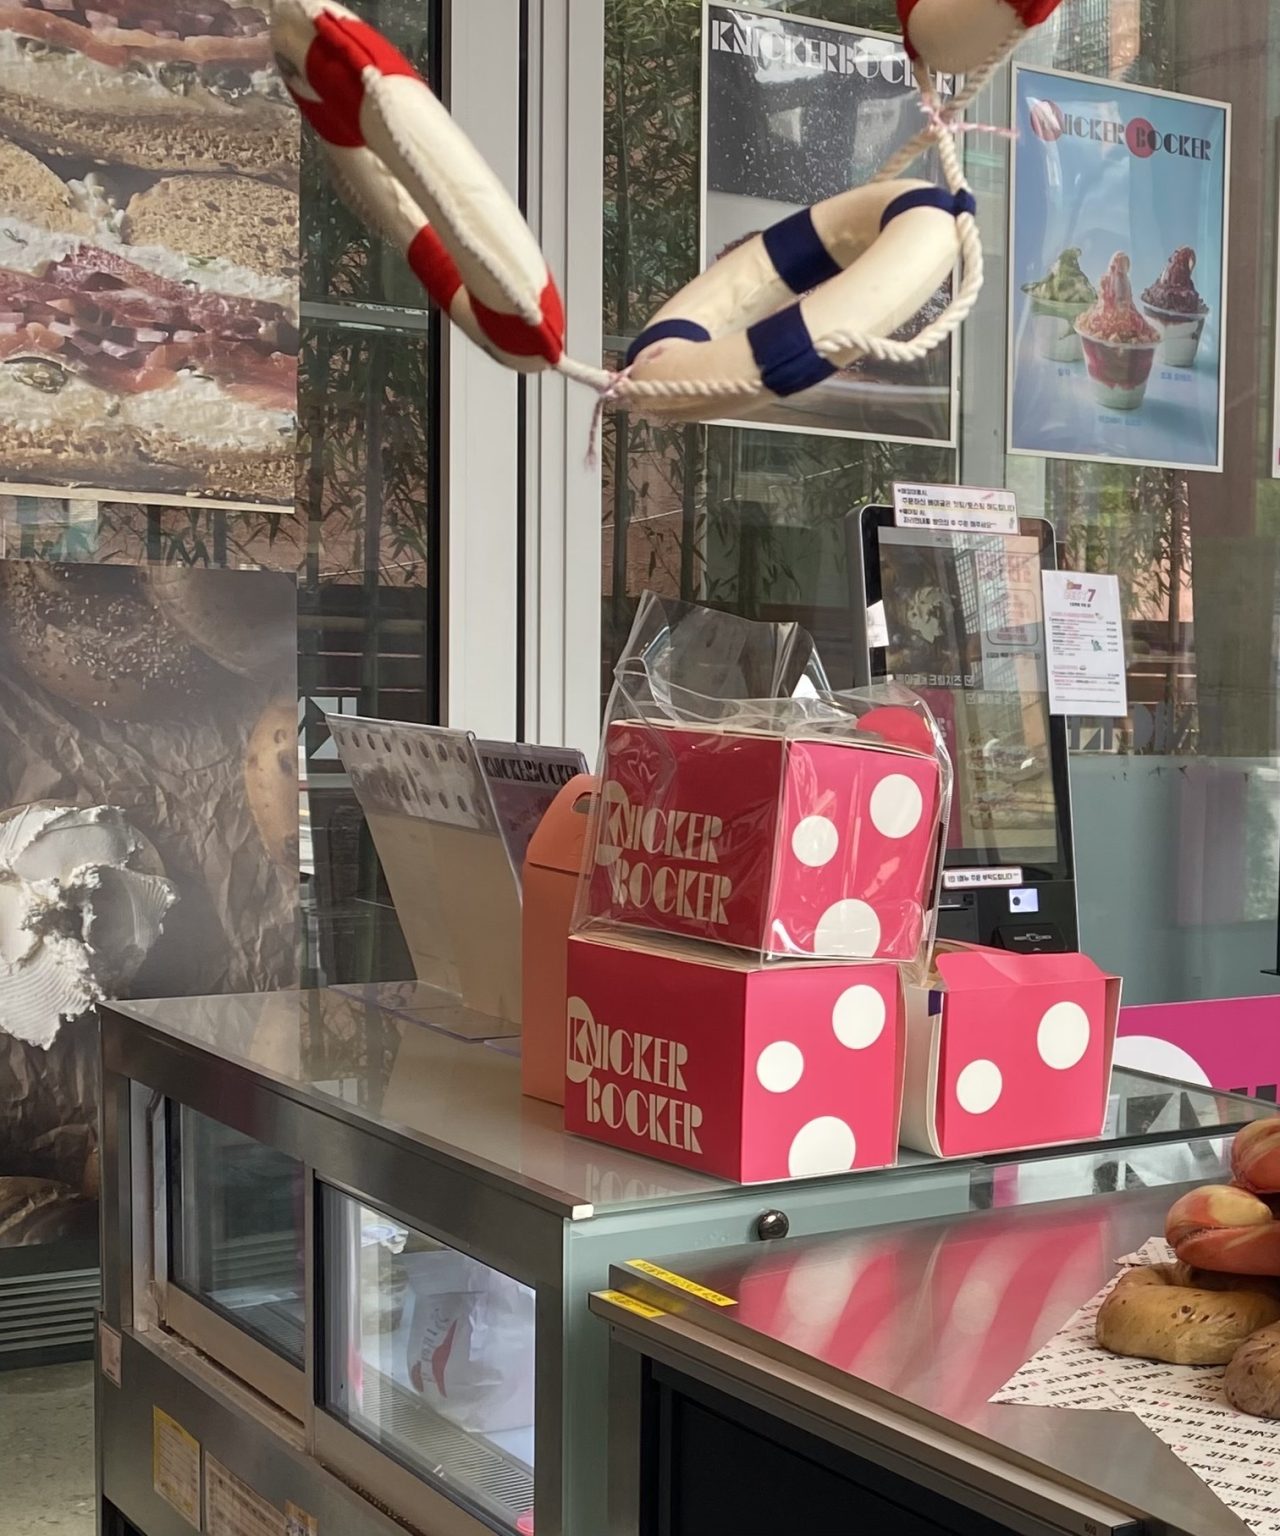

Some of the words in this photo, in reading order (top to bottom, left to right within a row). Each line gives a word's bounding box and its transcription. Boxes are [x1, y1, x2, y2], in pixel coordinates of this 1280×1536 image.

[712, 20, 953, 95] KNICKERBOCKR
[1136, 127, 1211, 161] BOCKER
[601, 800, 723, 864] KNICKER
[612, 858, 732, 925] BOCKER
[568, 1016, 689, 1092] KNICKER
[586, 1076, 703, 1154] BOCKER
